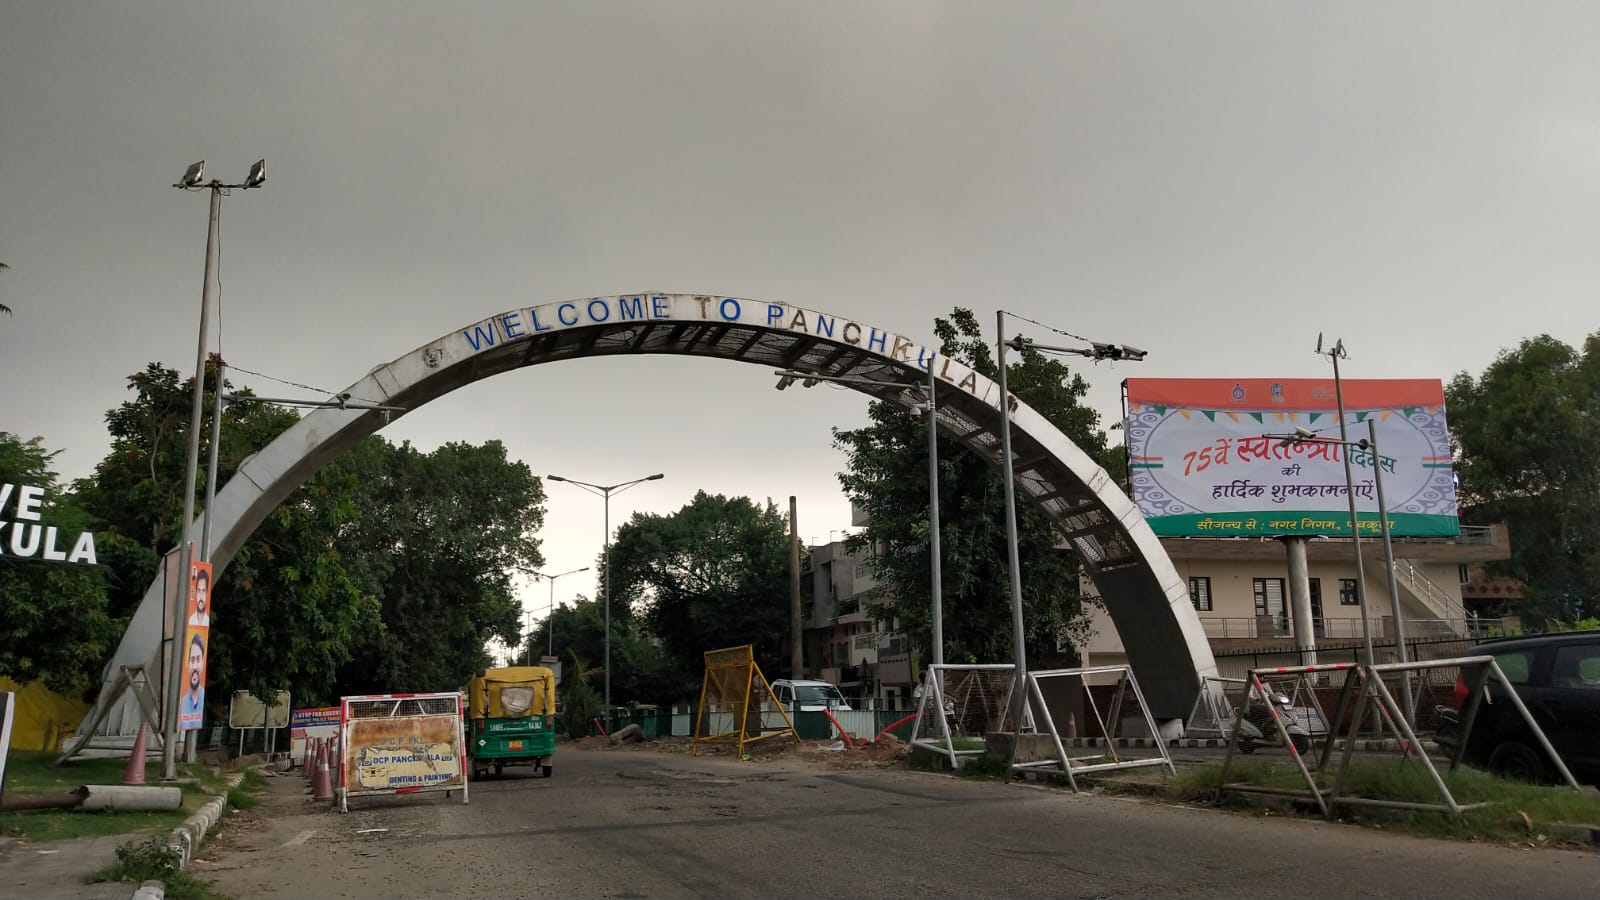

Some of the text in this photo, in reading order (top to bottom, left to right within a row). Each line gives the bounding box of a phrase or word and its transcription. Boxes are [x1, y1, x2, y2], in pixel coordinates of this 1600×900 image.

[463, 296, 977, 395] WELCOME TO PANCHKULA
[1183, 438, 1232, 476] 75वें
[1281, 463, 1303, 476] की
[1212, 480, 1266, 499] हार्दिक
[1197, 518, 1241, 530] सौजन्य
[1246, 518, 1257, 530] से
[1269, 520, 1297, 530] नगर
[1301, 517, 1341, 531] निगम,
[373, 754, 440, 764] DCP PANCLA
[389, 775, 416, 784] DENTING
[424, 773, 453, 781] PAINTING
